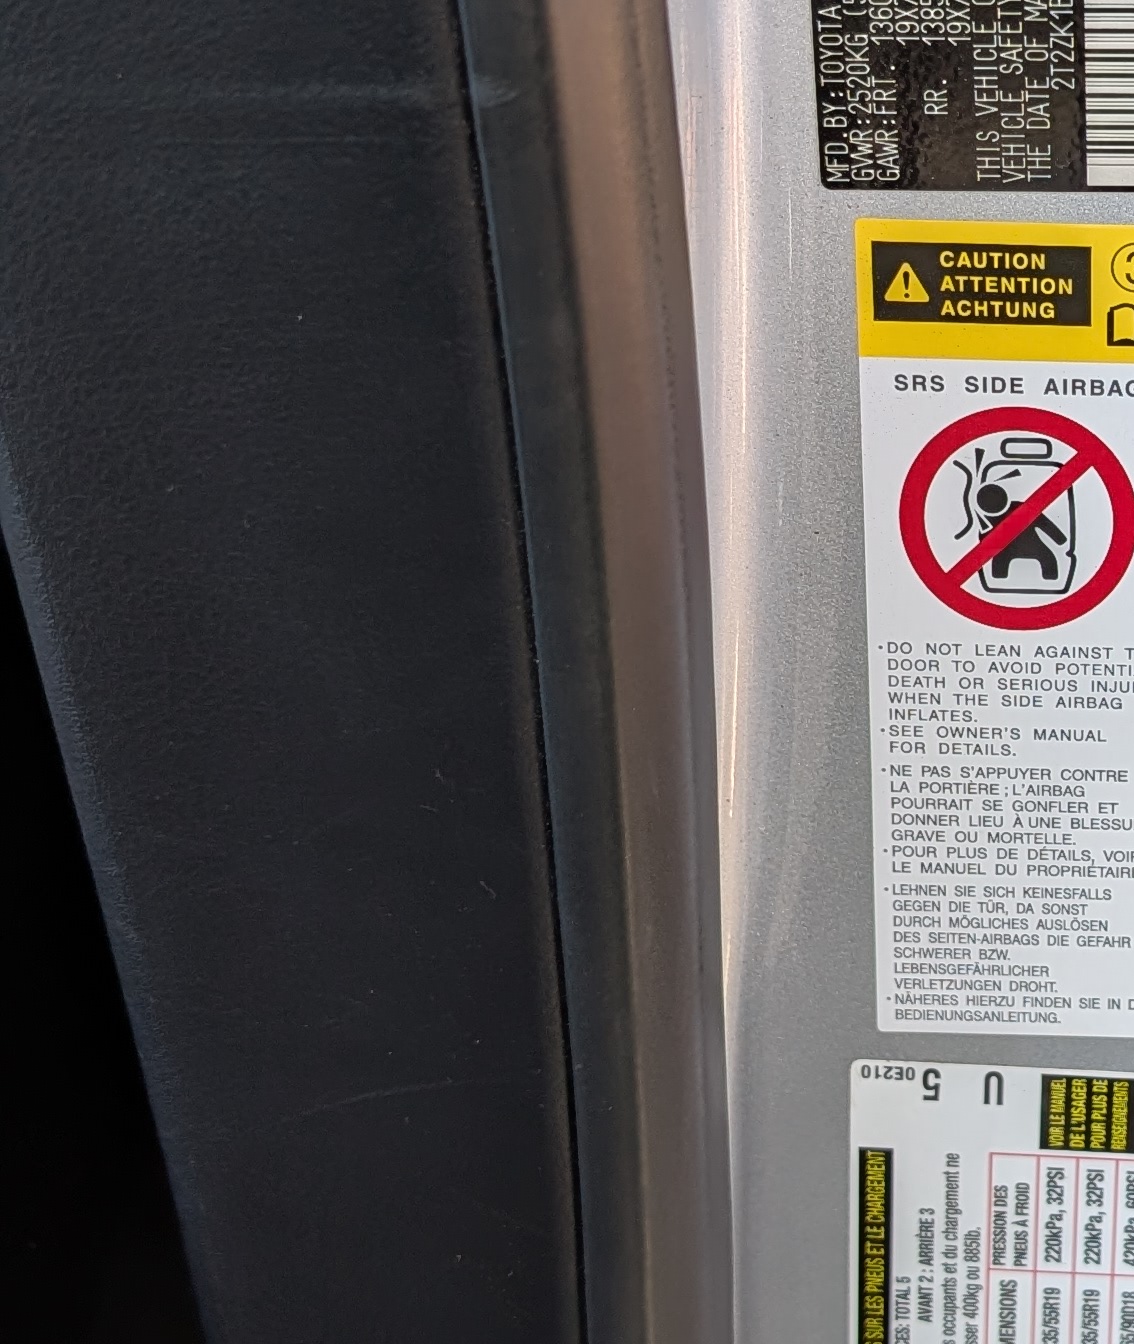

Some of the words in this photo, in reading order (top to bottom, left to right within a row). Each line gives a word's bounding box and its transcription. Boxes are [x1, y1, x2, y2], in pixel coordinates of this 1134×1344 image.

[1025, 38, 1048, 60] OF
[972, 22, 998, 115] VEHICLE
[926, 80, 949, 115] RR.
[1026, 77, 1049, 128] DATE
[1000, 91, 1025, 182] VEHICLE
[976, 131, 1000, 181] THIS
[1028, 145, 1050, 181] THE
[940, 251, 1045, 270] CAUTION
[940, 276, 1073, 294] ATTENTION
[941, 300, 1055, 318] ACHTUNG
[894, 375, 944, 392] SRS
[965, 377, 1024, 394] SIDE
[926, 643, 962, 656] NOT
[975, 644, 1021, 657] LEAN
[1034, 645, 1113, 659] AGAINST
[888, 659, 939, 672] DOOR
[952, 661, 975, 672] TO
[988, 661, 1041, 674] AVOID
[888, 675, 945, 688] DEATH
[959, 677, 984, 689] OR
[997, 678, 1078, 692] SERIOUS
[888, 693, 941, 705] WHEN
[953, 694, 988, 706] THE
[1002, 695, 1043, 707] SIDE
[1056, 696, 1122, 709] AIRBAG
[889, 709, 978, 722] INFLATES.
[1033, 728, 1107, 742] MANUAL
[890, 742, 925, 754] FOR
[939, 743, 1016, 756] DETAILS.
[921, 766, 951, 778] PAS
[1061, 769, 1128, 782] CONTRE
[891, 798, 973, 811] POURRAIT
[982, 800, 1003, 812] SE
[1012, 801, 1088, 814] GONFLER
[1098, 802, 1119, 814] ET
[891, 830, 946, 843] GRAVE
[955, 832, 978, 843] OU
[988, 832, 1076, 845] MORTELLE.
[947, 847, 987, 859] PLUS
[997, 848, 1018, 860] DE
[955, 886, 976, 898] SIE
[983, 887, 1015, 898] SICH
[1023, 887, 1111, 901] KEINESFALLS
[894, 932, 920, 944] DES
[929, 933, 1039, 946] SEITEN-AIRBAGS
[1048, 935, 1069, 947] DIE
[1077, 936, 1131, 948] GEFAHR
[922, 1067, 941, 1100] 5
[983, 1070, 1003, 1105] U
